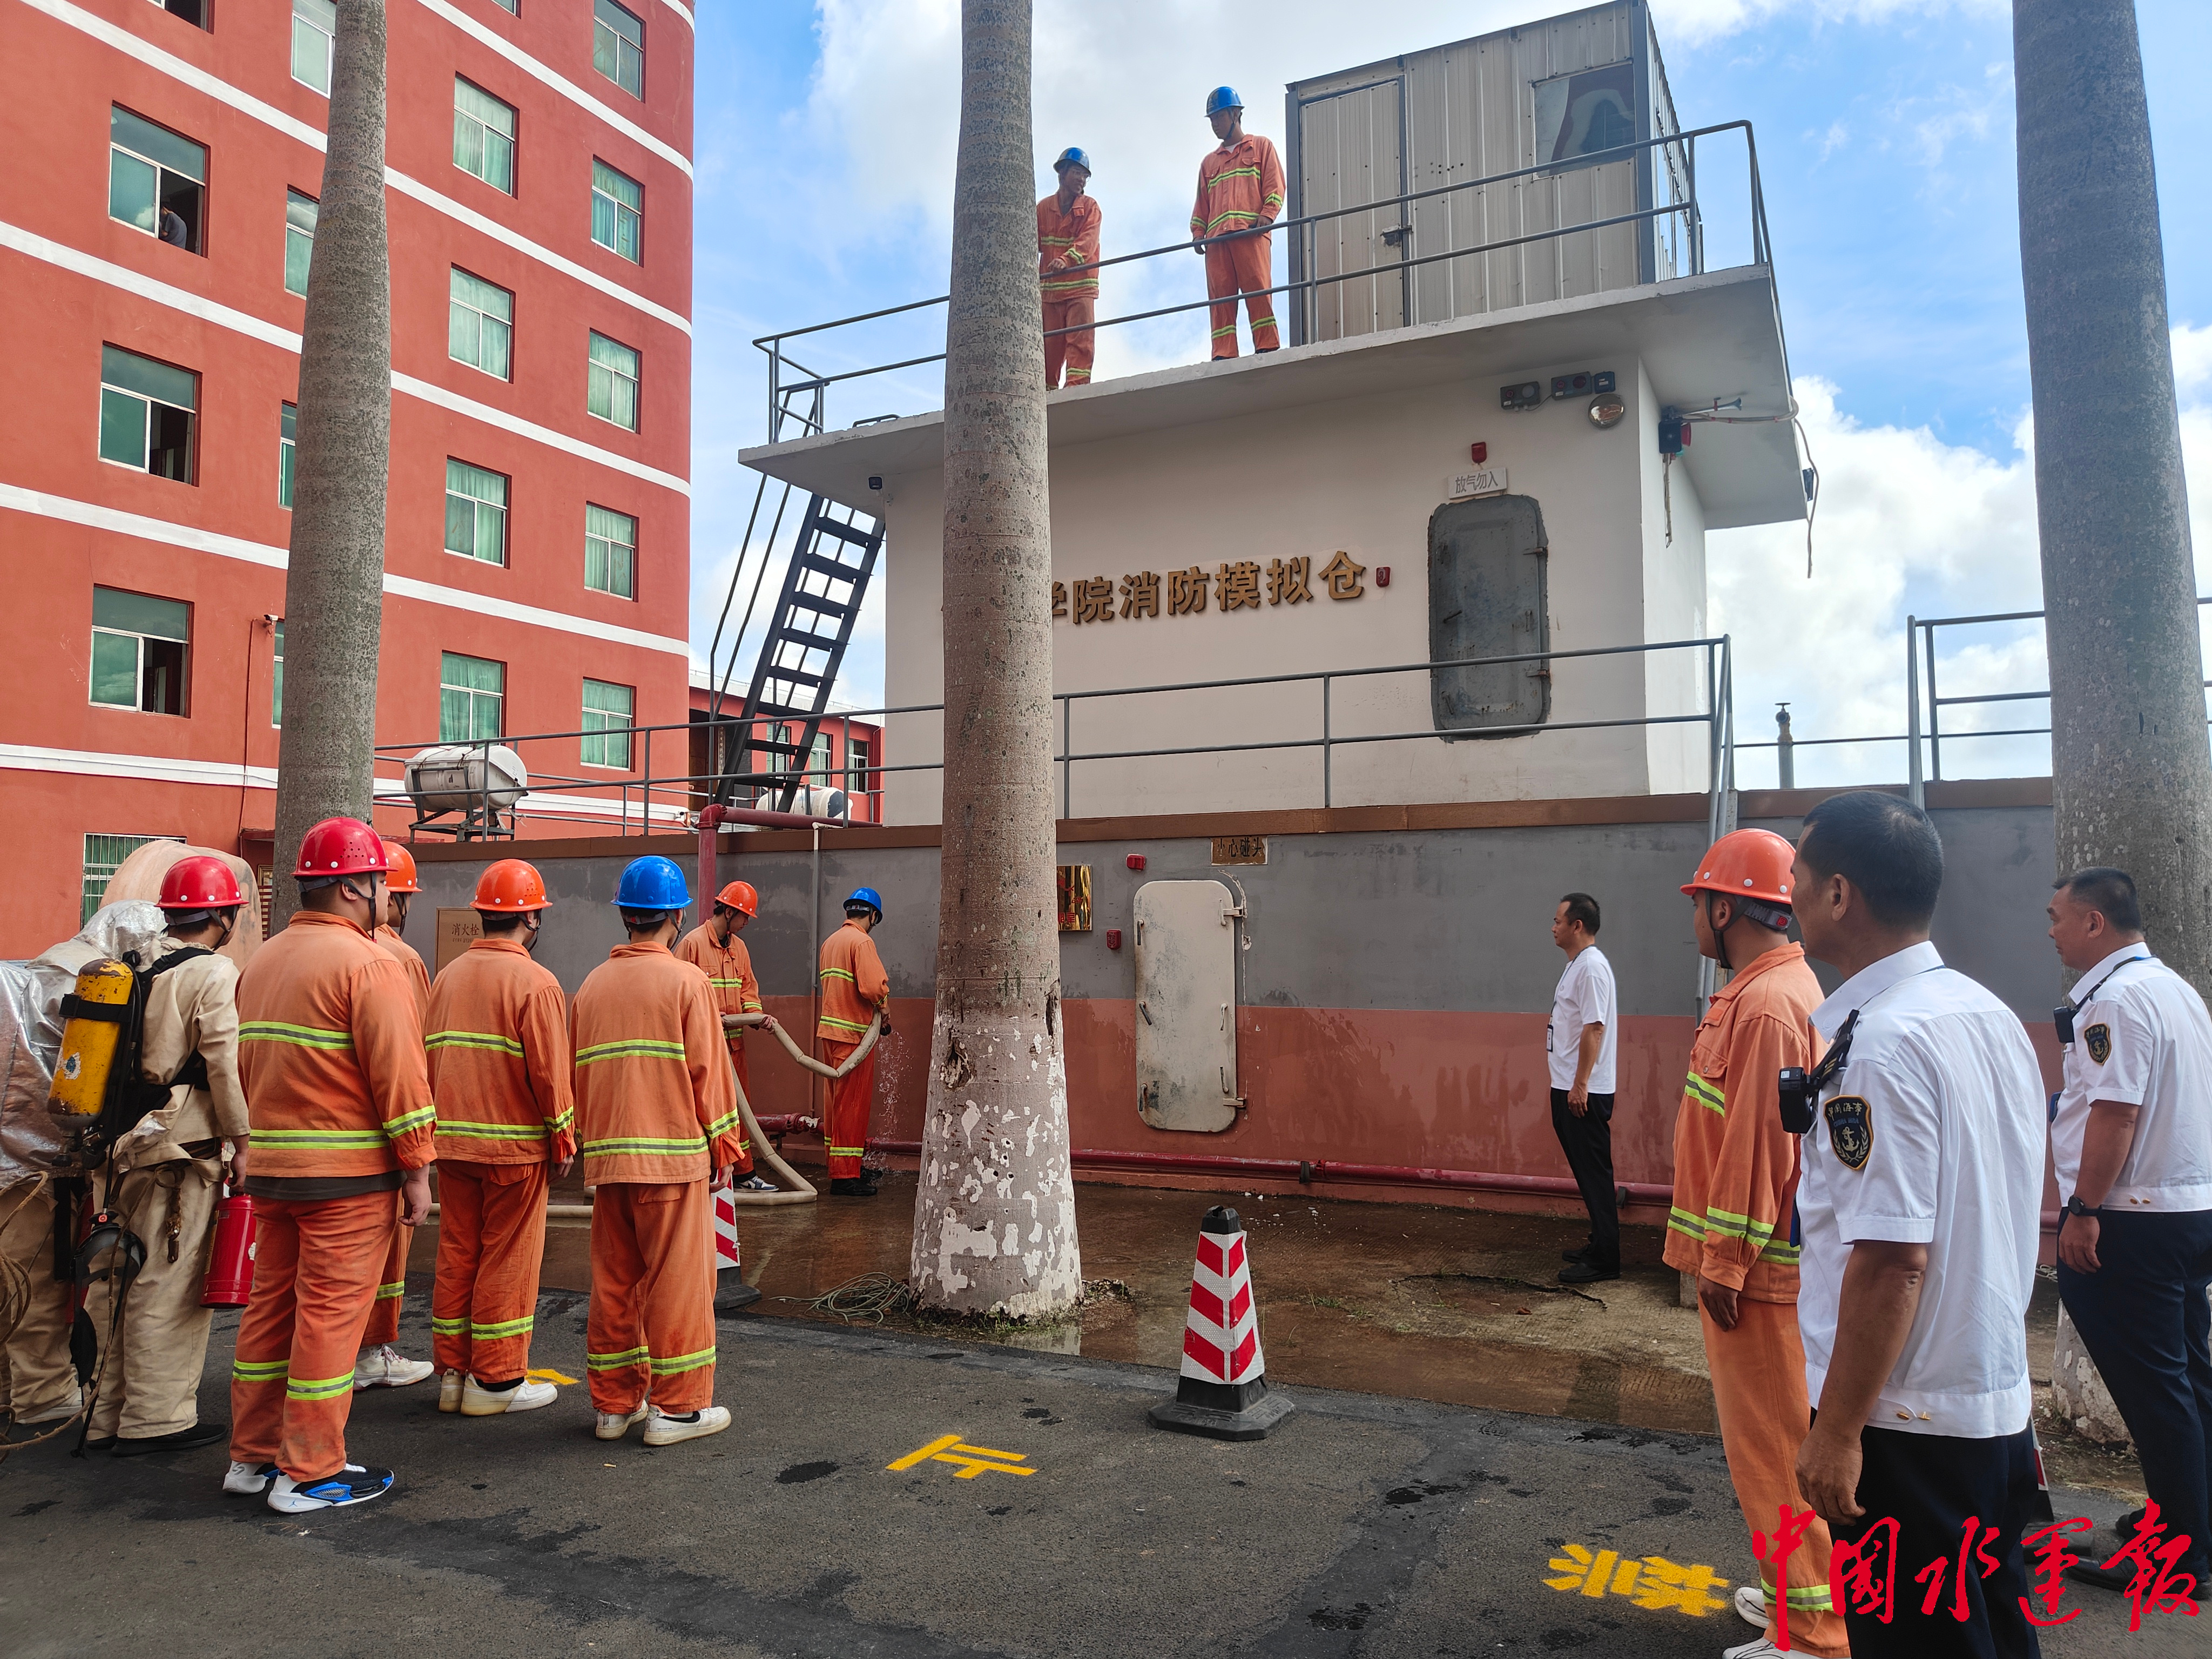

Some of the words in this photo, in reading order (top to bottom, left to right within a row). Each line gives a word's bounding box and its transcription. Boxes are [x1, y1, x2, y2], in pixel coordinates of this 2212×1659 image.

[1455, 471, 1499, 494] 放气勿入
[1217, 837, 1262, 858] 小心碰头
[451, 922, 480, 936] 消火栓
